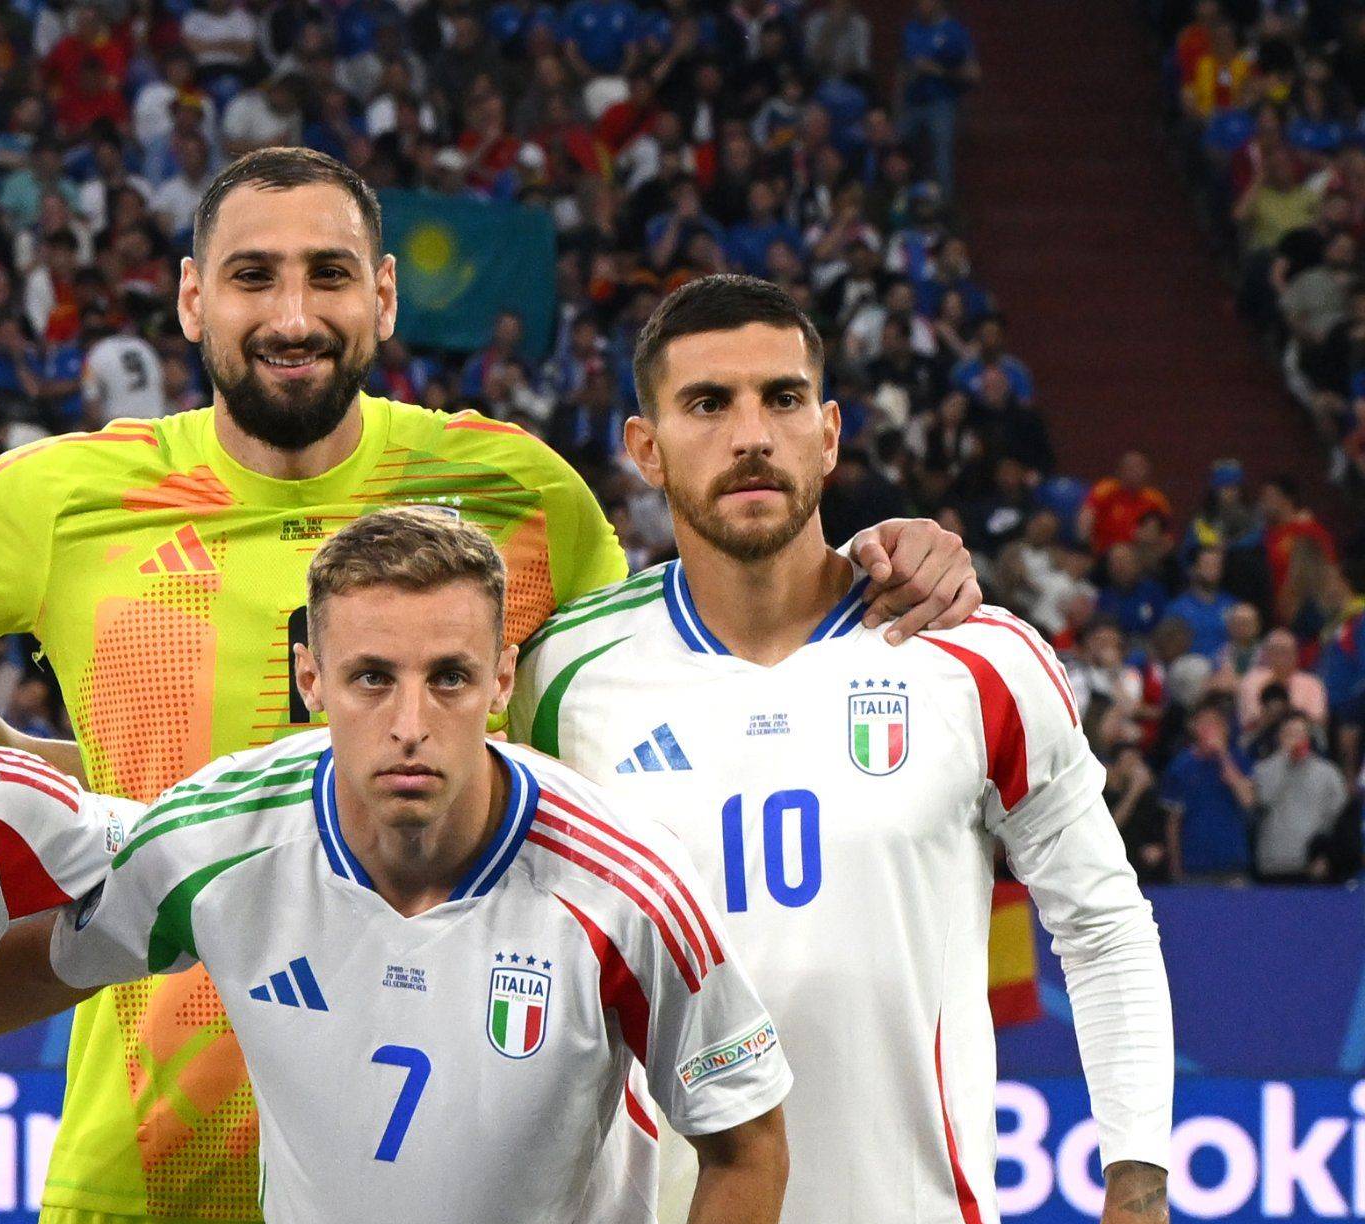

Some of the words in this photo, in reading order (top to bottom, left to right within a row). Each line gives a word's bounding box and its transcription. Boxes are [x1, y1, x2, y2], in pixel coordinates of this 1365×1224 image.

[853, 700, 903, 715] ITALIA
[721, 789, 821, 913] 10
[495, 974, 544, 997] ITALIA
[682, 1025, 774, 1084] FOUNDATION
[372, 1045, 431, 1162] 7
